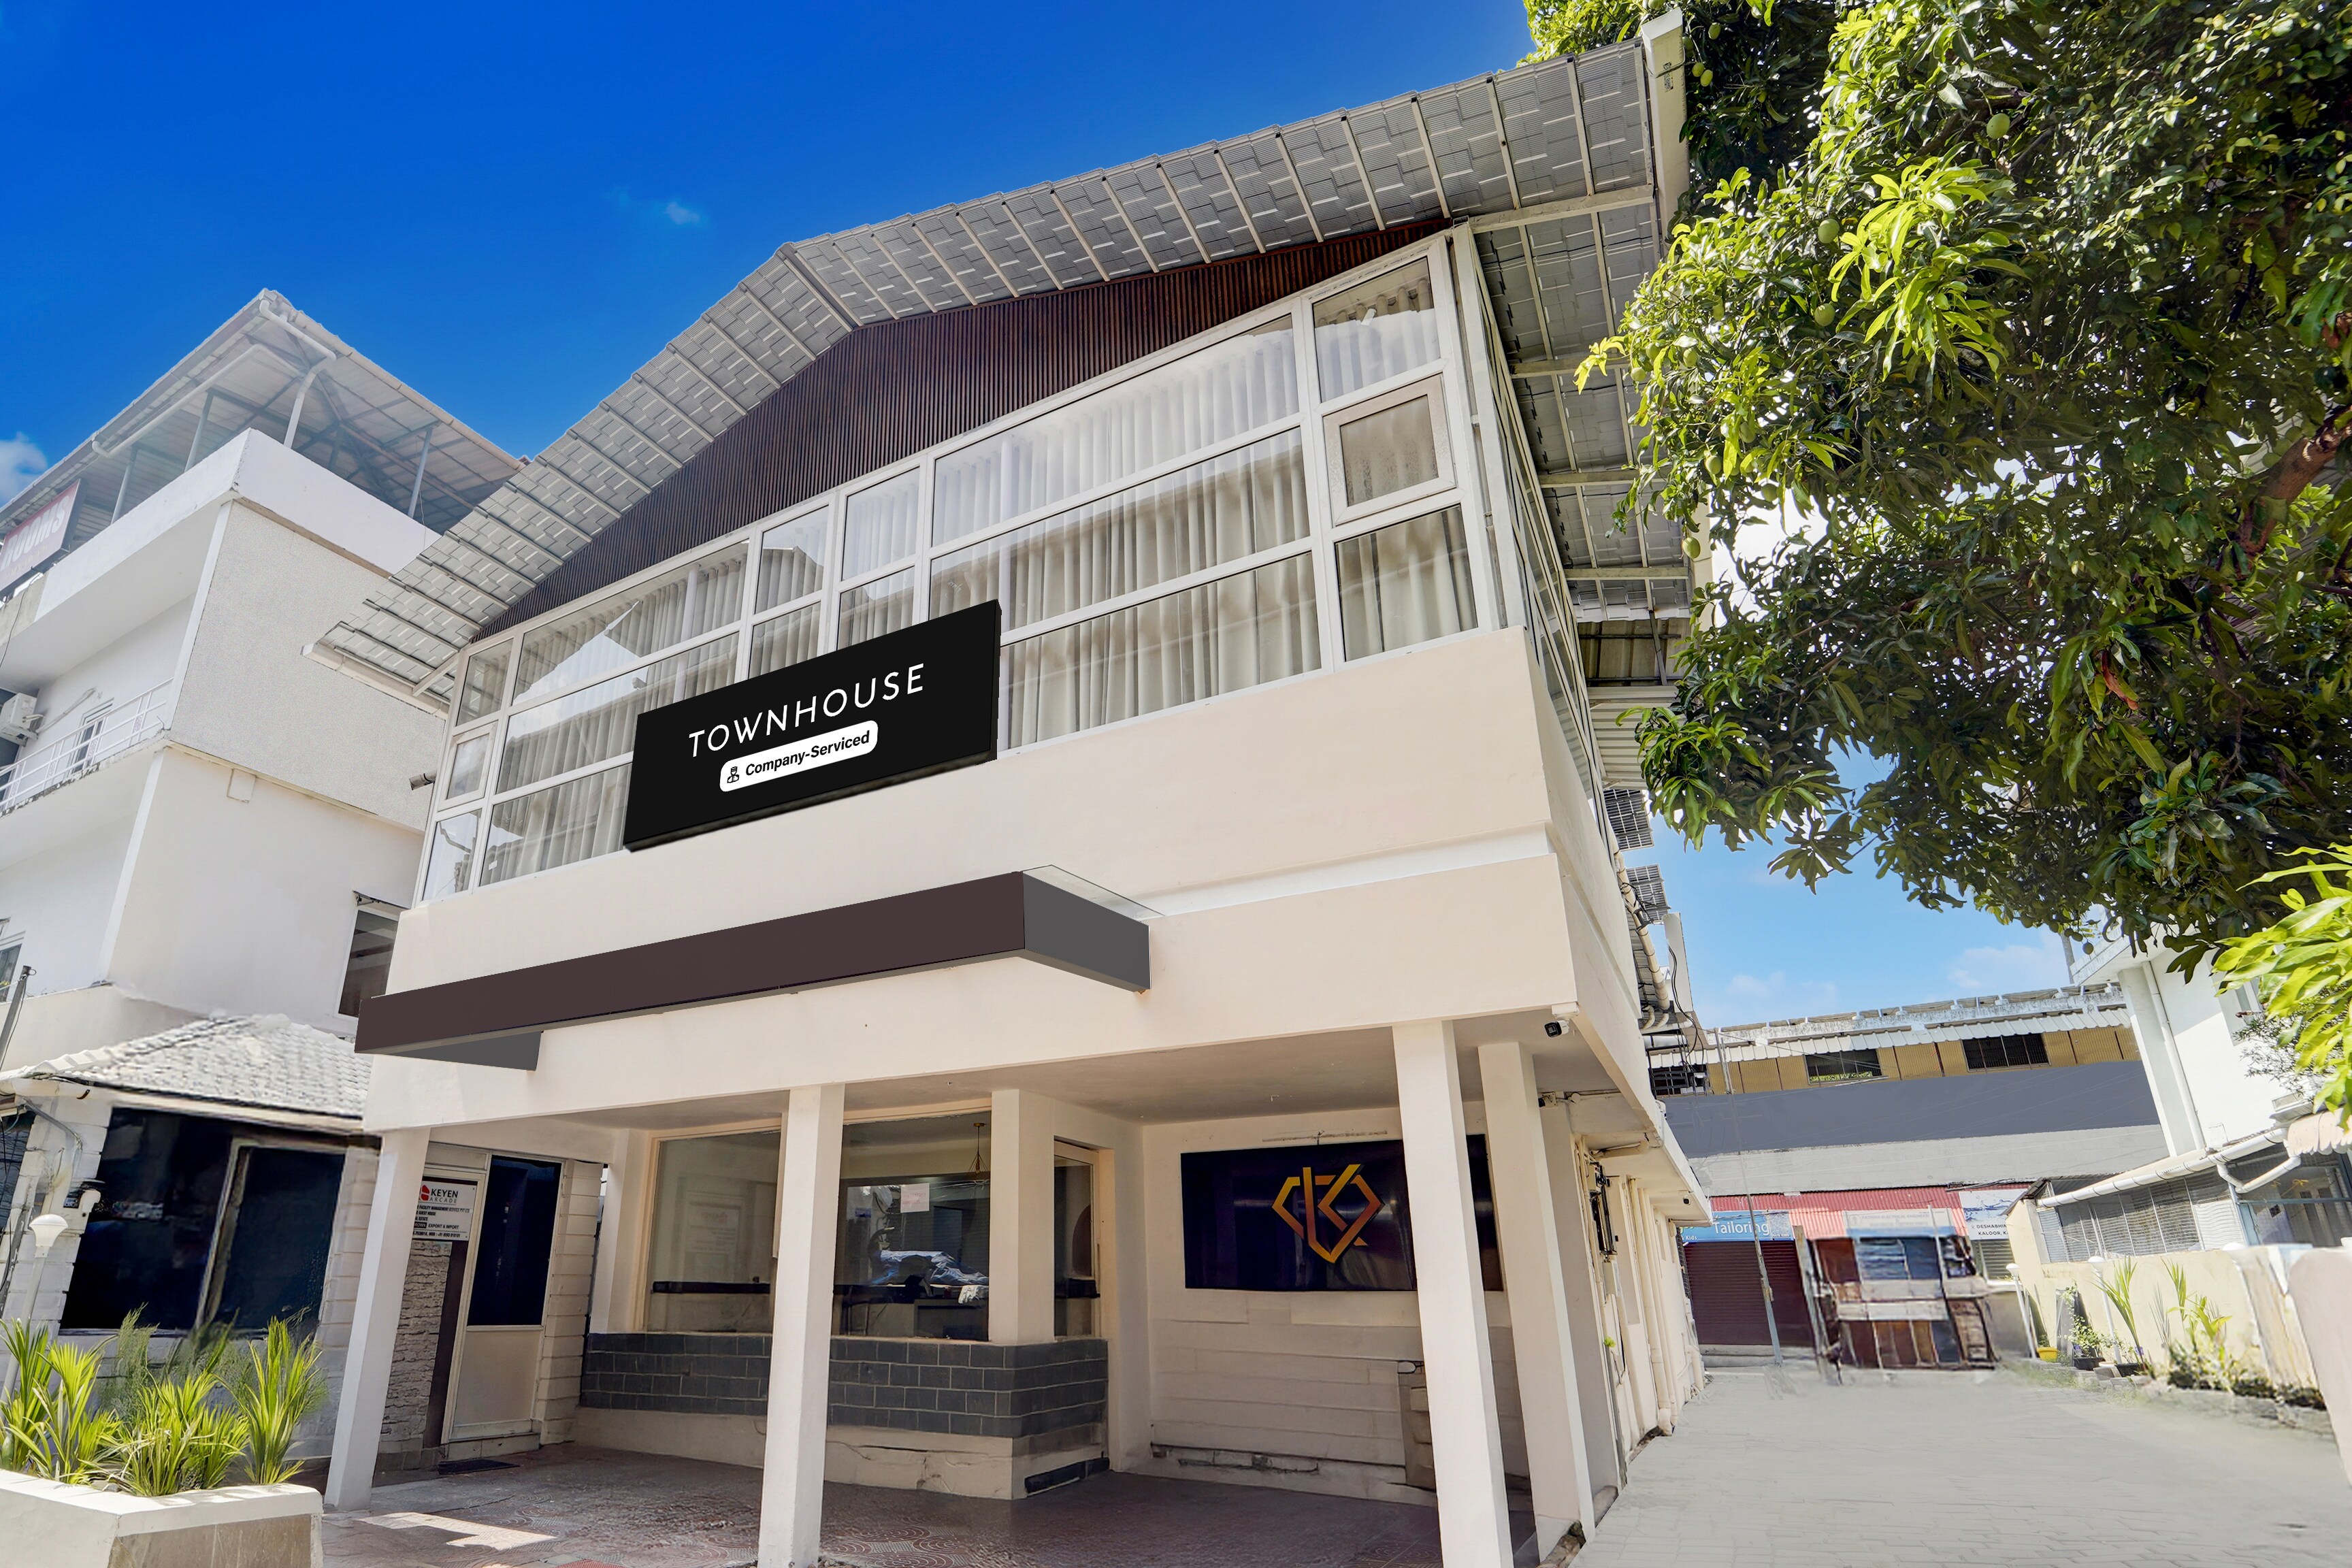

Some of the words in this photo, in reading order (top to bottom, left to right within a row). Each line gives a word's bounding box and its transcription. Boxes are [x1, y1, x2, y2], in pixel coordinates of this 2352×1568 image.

[0, 495, 69, 572] ROOMS
[689, 663, 924, 757] TOWNHOUSE
[745, 730, 870, 776] Company-Serviced
[431, 1188, 459, 1198] KEYEN
[1712, 1222, 1770, 1236] Tailoring
